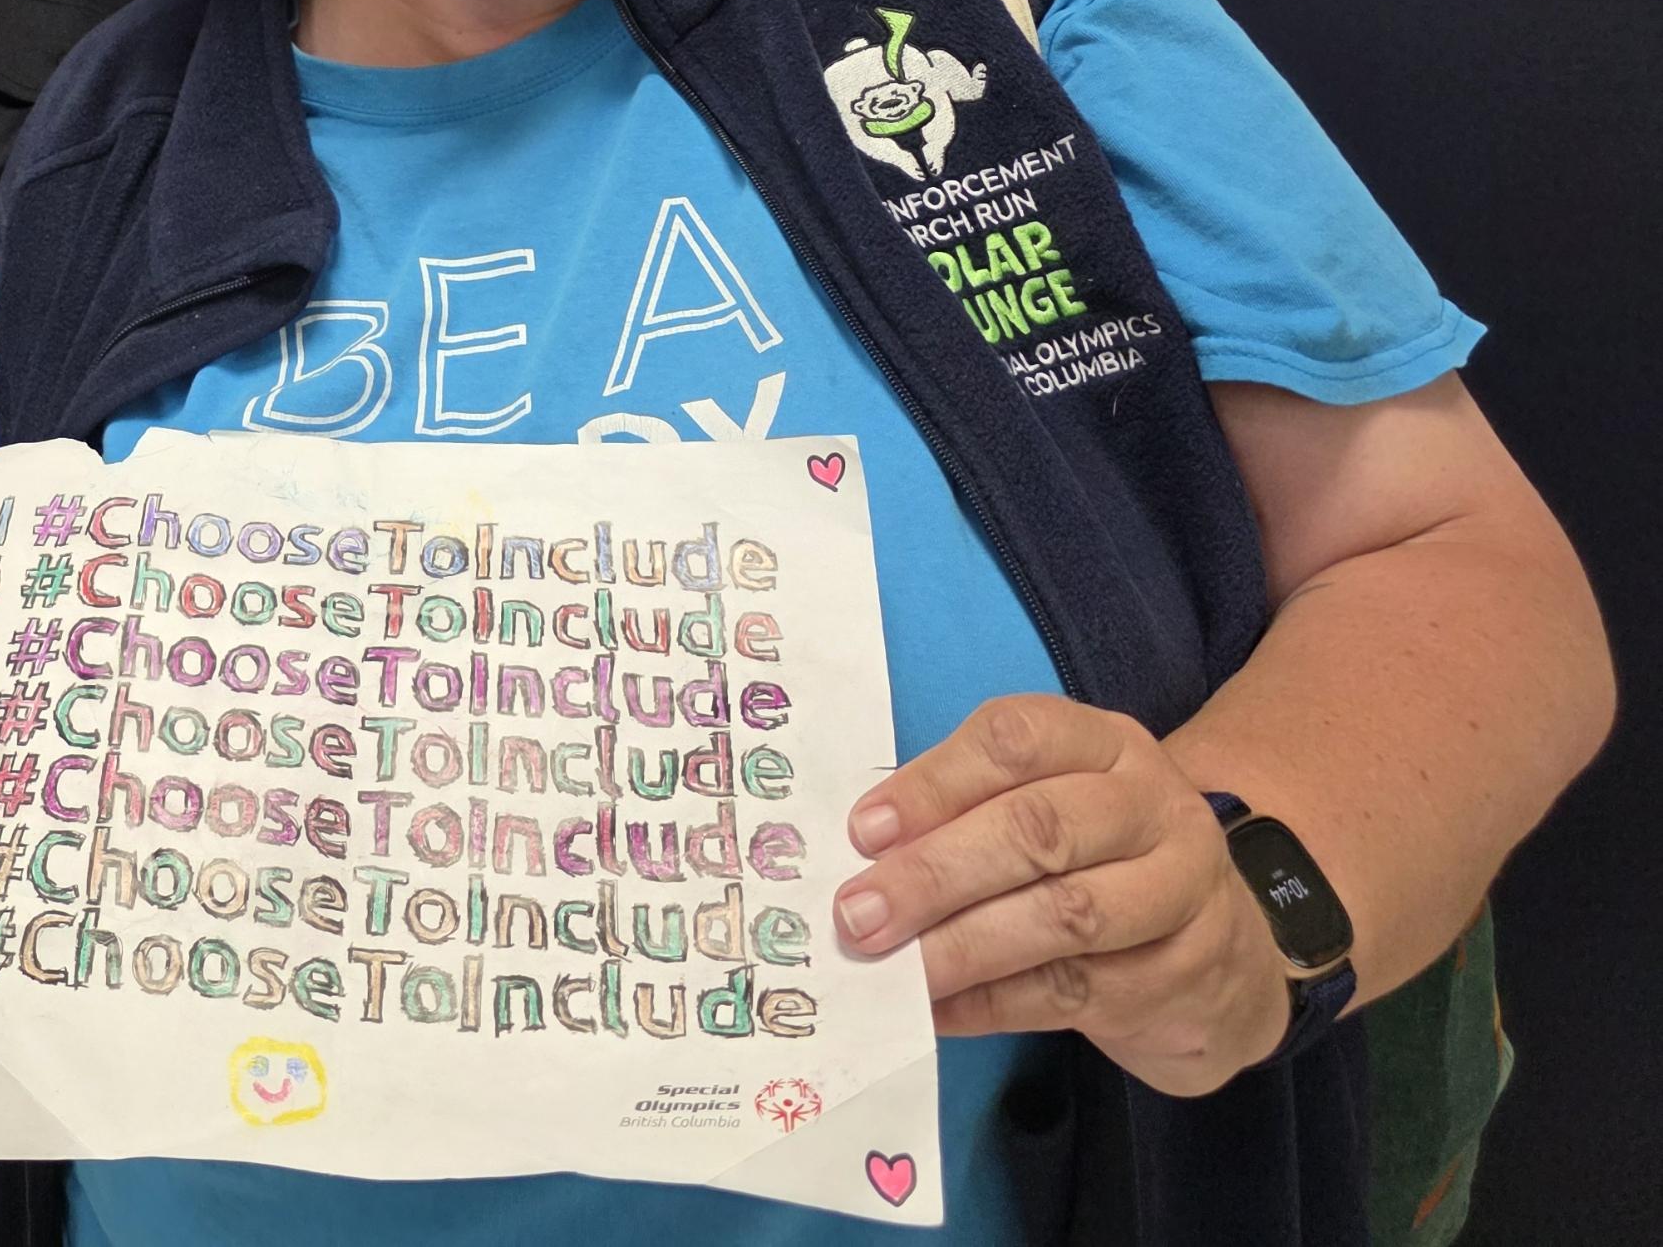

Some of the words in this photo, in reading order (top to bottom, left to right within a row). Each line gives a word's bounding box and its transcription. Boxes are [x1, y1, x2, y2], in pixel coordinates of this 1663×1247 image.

[881, 133, 1077, 223] NFORCEMENT
[974, 188, 1038, 230] RUN
[1034, 313, 1162, 366] OLYMPICS
[1024, 346, 1147, 397] COLUMBIA
[34, 493, 780, 592] #ChooseToInclude
[21, 552, 785, 662] #ChooseToInclude
[5, 614, 793, 730] #ChooseToInclude
[1268, 875, 1309, 908] 10:44
[635, 1099, 742, 1114] Olympics
[656, 1084, 740, 1097] Special
[619, 1115, 668, 1128] British
[671, 1115, 741, 1128] Columbia
